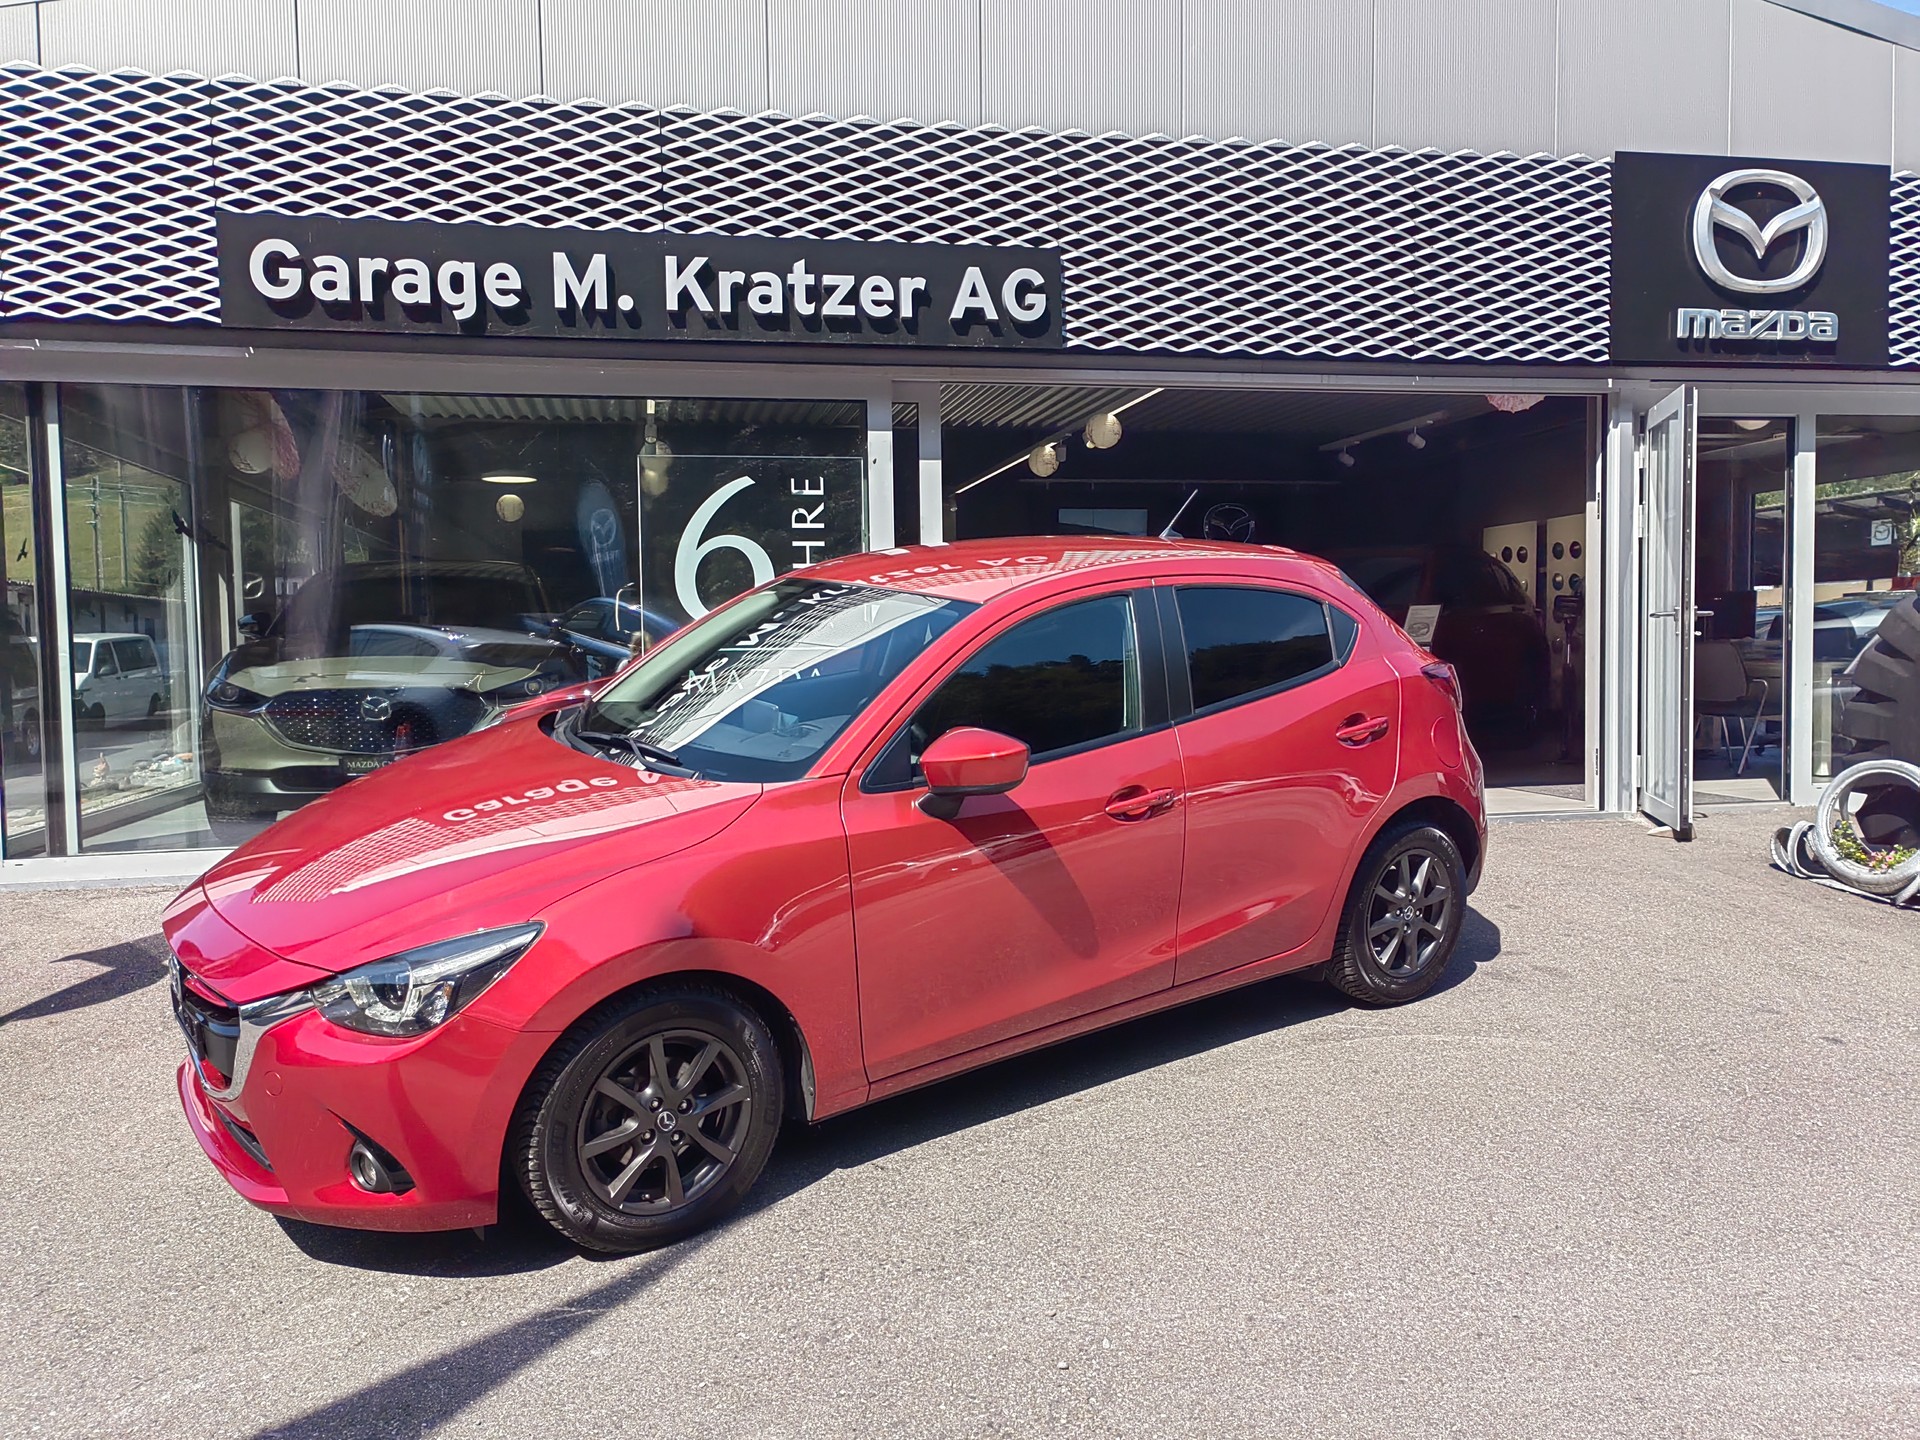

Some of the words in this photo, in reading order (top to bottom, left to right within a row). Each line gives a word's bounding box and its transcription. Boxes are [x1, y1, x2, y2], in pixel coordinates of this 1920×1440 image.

[249, 238, 522, 321] Garage
[552, 251, 635, 311] M.
[665, 255, 927, 318] Kratzer
[949, 266, 1048, 322] AG
[674, 475, 776, 621] 6
[347, 760, 380, 769] MAZDA
